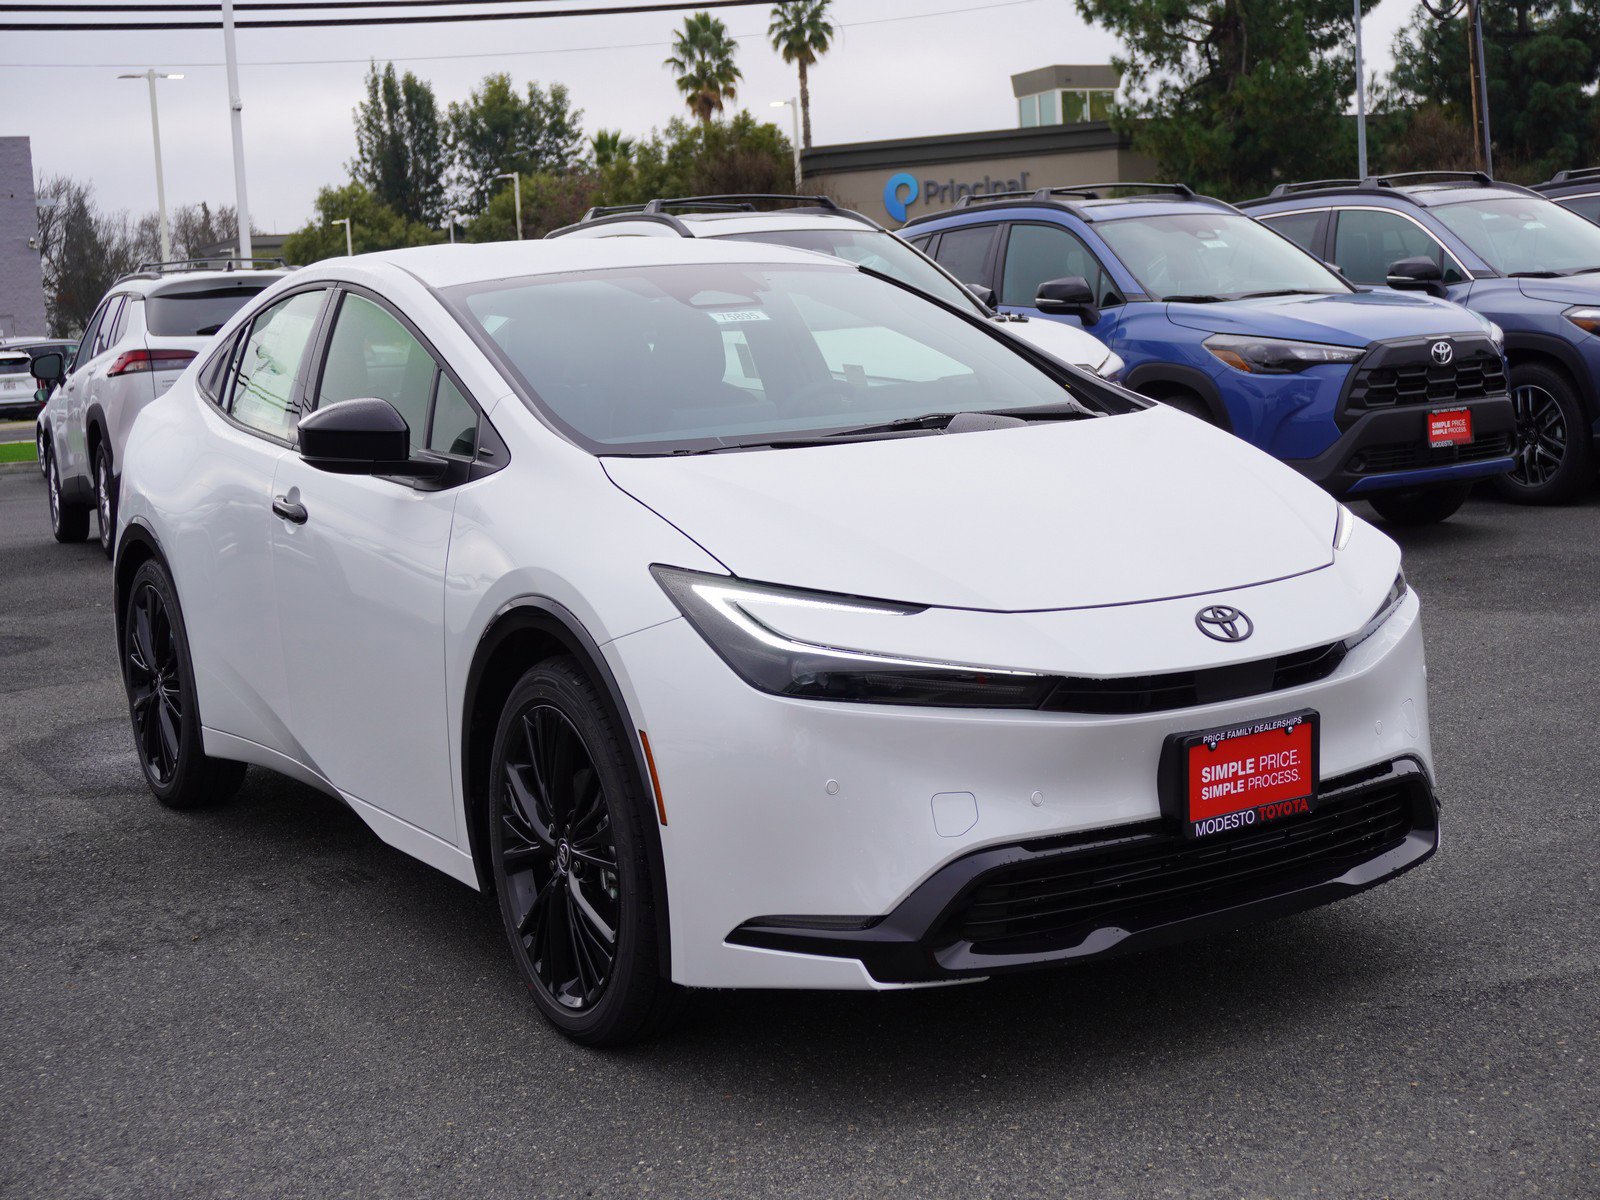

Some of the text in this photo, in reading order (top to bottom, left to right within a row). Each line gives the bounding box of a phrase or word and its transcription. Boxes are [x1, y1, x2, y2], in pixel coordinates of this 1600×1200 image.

[924, 172, 1028, 205] Principal
[1432, 421, 1450, 429] SIMPLE
[1432, 440, 1453, 448] MODESTO
[1203, 717, 1302, 743] PRICE FAMILY DEALERSHIPS
[1201, 749, 1301, 783] SIMPLE PRICE.
[1201, 769, 1301, 800] SIMPLE PROCESS.
[1195, 798, 1309, 837] MODESTO TOYOTA
